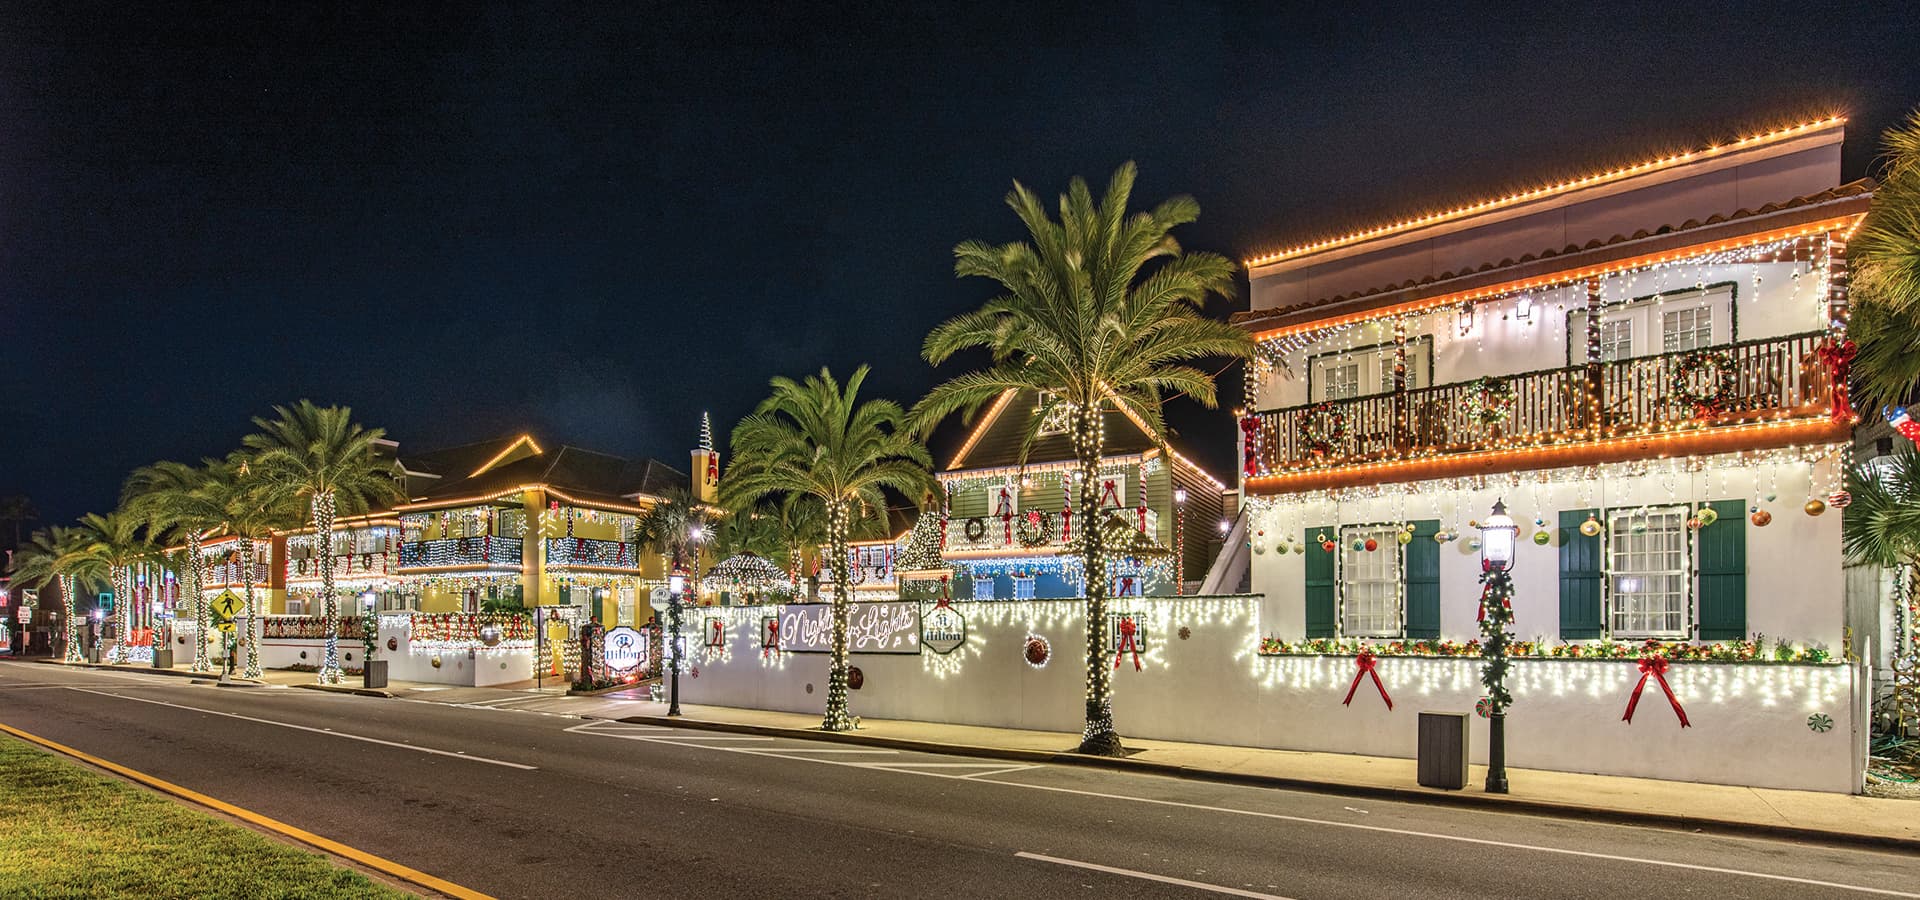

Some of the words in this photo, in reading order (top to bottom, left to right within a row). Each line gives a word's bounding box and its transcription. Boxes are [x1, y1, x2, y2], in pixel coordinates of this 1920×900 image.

[857, 605, 914, 648] Lights
[926, 630, 961, 641] Hilton
[606, 648, 640, 660] Hilton
